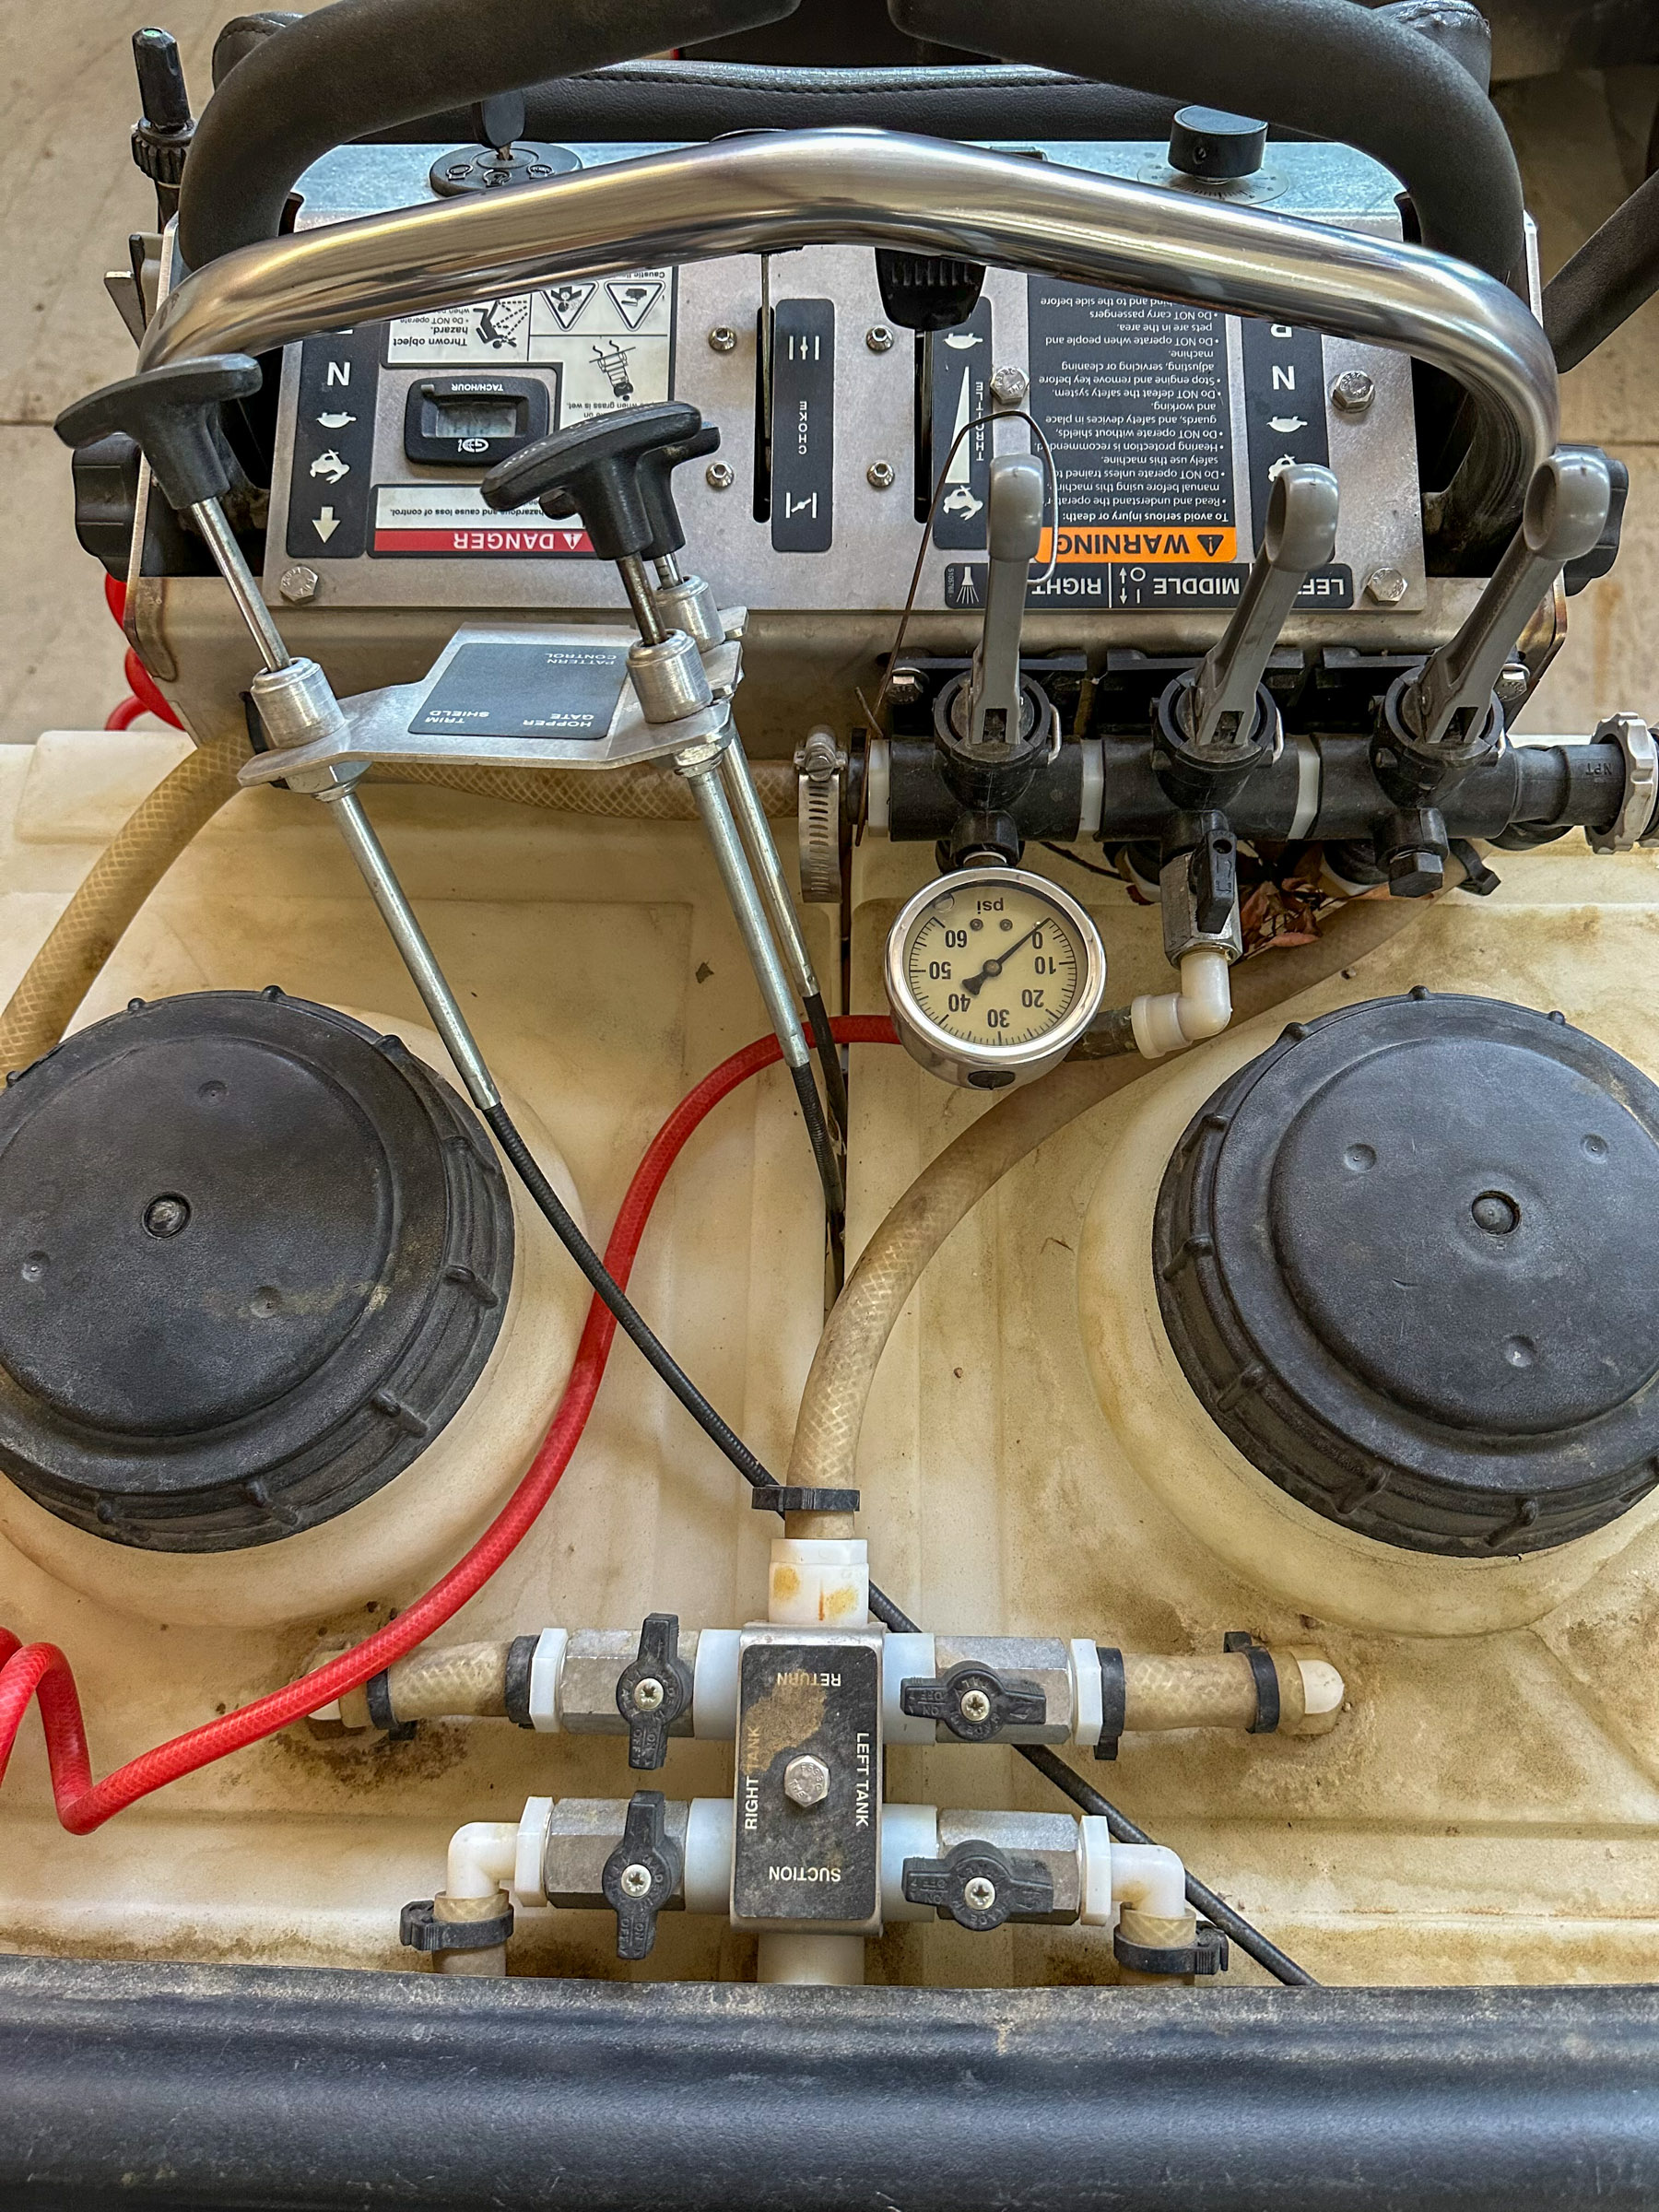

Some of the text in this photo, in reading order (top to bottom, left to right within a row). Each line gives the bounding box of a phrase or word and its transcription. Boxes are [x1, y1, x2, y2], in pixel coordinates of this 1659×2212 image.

[1041, 298, 1073, 306] before
[1076, 298, 1095, 306] side
[1098, 298, 1113, 306] the
[1129, 298, 1147, 306] and
[1090, 310, 1211, 320] Do NOT carry passengers
[1143, 324, 1159, 333] the
[1162, 324, 1171, 333] in
[1192, 323, 1212, 332] pets
[394, 337, 425, 347] object
[1045, 335, 1212, 346] Do NOT operate when people and
[1169, 350, 1213, 359] machine.
[1062, 361, 1103, 372] cleaning
[1119, 361, 1162, 371] servicing
[1165, 361, 1214, 372] adjusting,
[327, 362, 350, 386] N
[1272, 366, 1295, 390] N
[1039, 375, 1214, 385] Stop engine and remove key before
[1053, 388, 1215, 398] Do NOT defeat the safety system.
[1151, 401, 1216, 412] and working.
[1045, 415, 1217, 425] guards, and safety devices in place
[798, 401, 807, 455] CHOKE
[1056, 428, 1217, 439] Do NOT operate without shields,
[1035, 441, 1218, 452] Hearing protection is recommendd.
[1101, 456, 1147, 465] machine.
[1149, 456, 1167, 465] this
[1190, 455, 1218, 465] safely
[1065, 470, 1101, 479] trained
[1104, 470, 1135, 479] unless
[1138, 468, 1177, 477] operate
[1180, 470, 1201, 478] NOT
[1205, 470, 1218, 478] Do
[1096, 484, 1113, 492] this
[1117, 481, 1143, 492] using
[1147, 484, 1179, 492] before
[1182, 484, 1219, 492] manual
[1094, 497, 1110, 506] the
[1114, 497, 1170, 506] understand
[1173, 497, 1192, 506] and
[1195, 497, 1219, 506] Read
[1063, 513, 1096, 523] death:
[1112, 512, 1142, 522] injury
[1145, 513, 1181, 522] serious
[1184, 513, 1212, 523] avoid
[1216, 513, 1229, 522] To
[453, 533, 554, 549] DANGER
[1057, 535, 1190, 554] WARNING
[1031, 578, 1101, 594] RIGHT
[1153, 578, 1240, 594] MIDDLE
[1297, 579, 1344, 594] LEF
[1585, 763, 1612, 775] NPT
[976, 898, 1004, 914] psi
[946, 930, 967, 947] 60
[1032, 932, 1043, 949] 0
[929, 961, 951, 979] 50
[1034, 957, 1056, 974] 10
[948, 994, 971, 1012] 40
[1022, 989, 1044, 1007] 20
[987, 1009, 1010, 1028] 30
[777, 1672, 841, 1687] RETURN
[745, 1725, 760, 1830] RIGHT TANK
[855, 1733, 869, 1826] LEFT TANK
[769, 1866, 841, 1882] SUCTION
